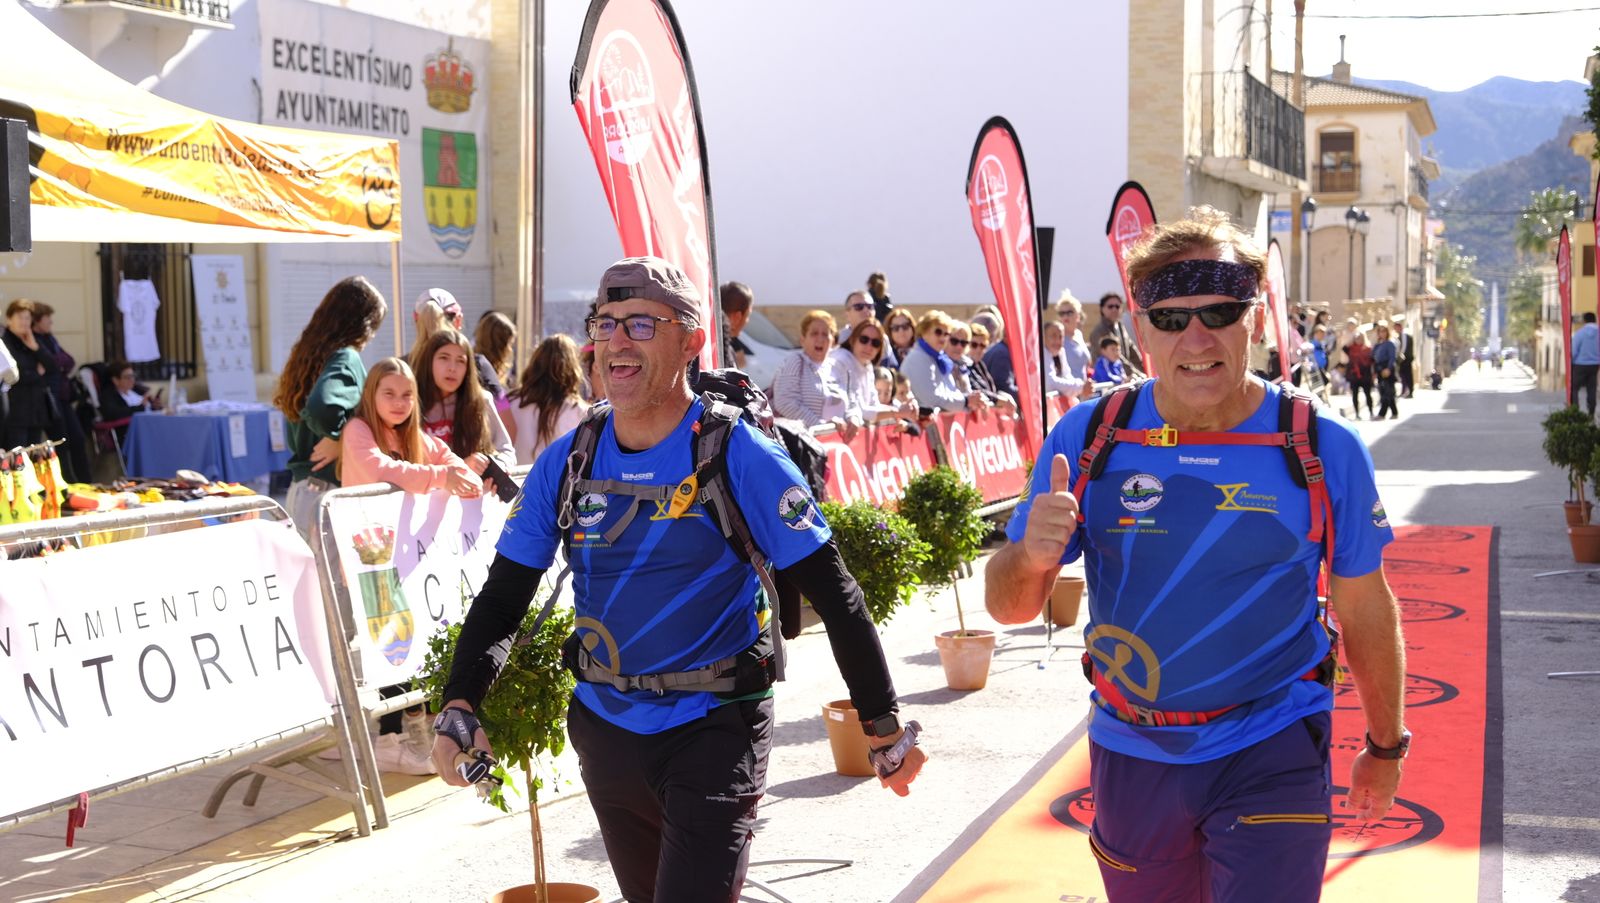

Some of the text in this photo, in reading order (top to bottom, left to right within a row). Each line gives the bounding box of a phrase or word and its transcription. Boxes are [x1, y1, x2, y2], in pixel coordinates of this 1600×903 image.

[272, 37, 413, 91] EXCELENTÍSIMO
[276, 89, 410, 136] AYUNTAMIENTO
[969, 433, 1024, 477] VEOLIA
[243, 574, 281, 607] DE
[424, 563, 490, 622] CA
